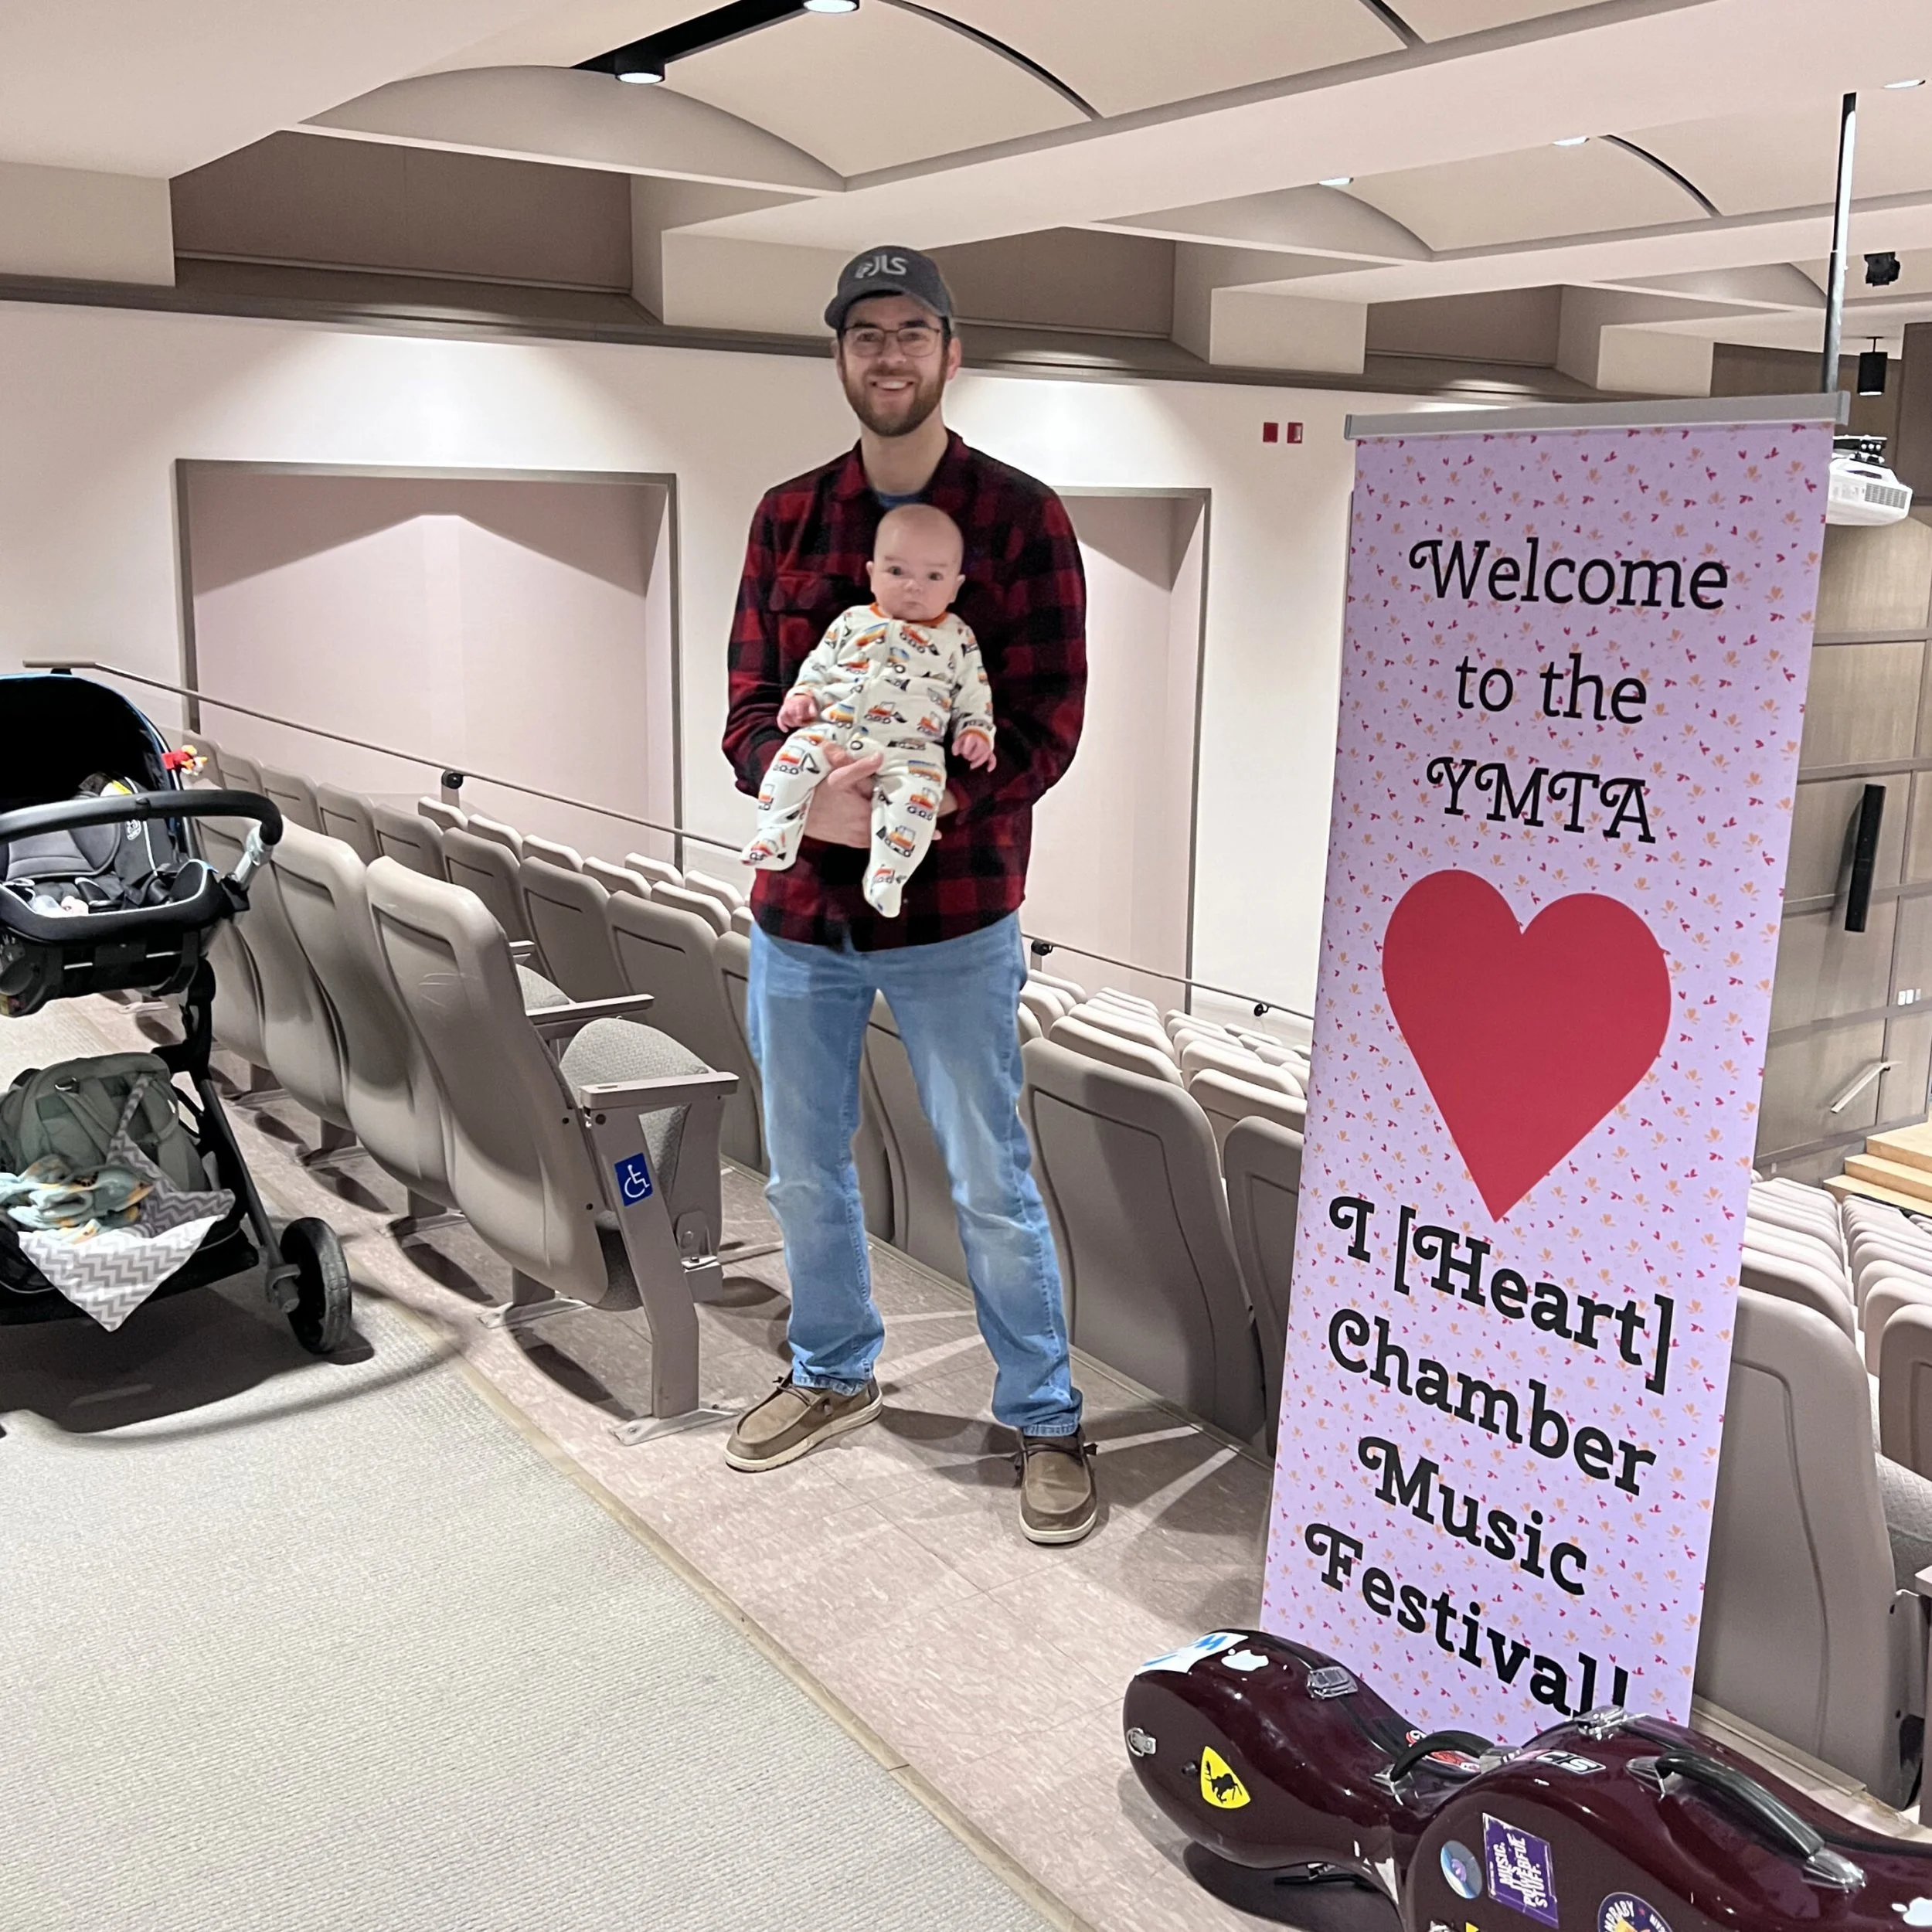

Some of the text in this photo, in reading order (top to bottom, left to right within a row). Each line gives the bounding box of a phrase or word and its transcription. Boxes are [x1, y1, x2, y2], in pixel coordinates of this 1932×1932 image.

[1409, 536, 1729, 611] Welcome
[1455, 652, 1648, 725] to the
[1426, 757, 1656, 844] YMTA
[1328, 1196, 1675, 1396] I [Heart]
[1328, 1308, 1658, 1496] Chamber
[1358, 1435, 1588, 1596] Music
[1492, 1842, 1513, 1886] MUSIC.
[1528, 1862, 1549, 1908] STUFF.
[1604, 1900, 1635, 1932] MPBABY
